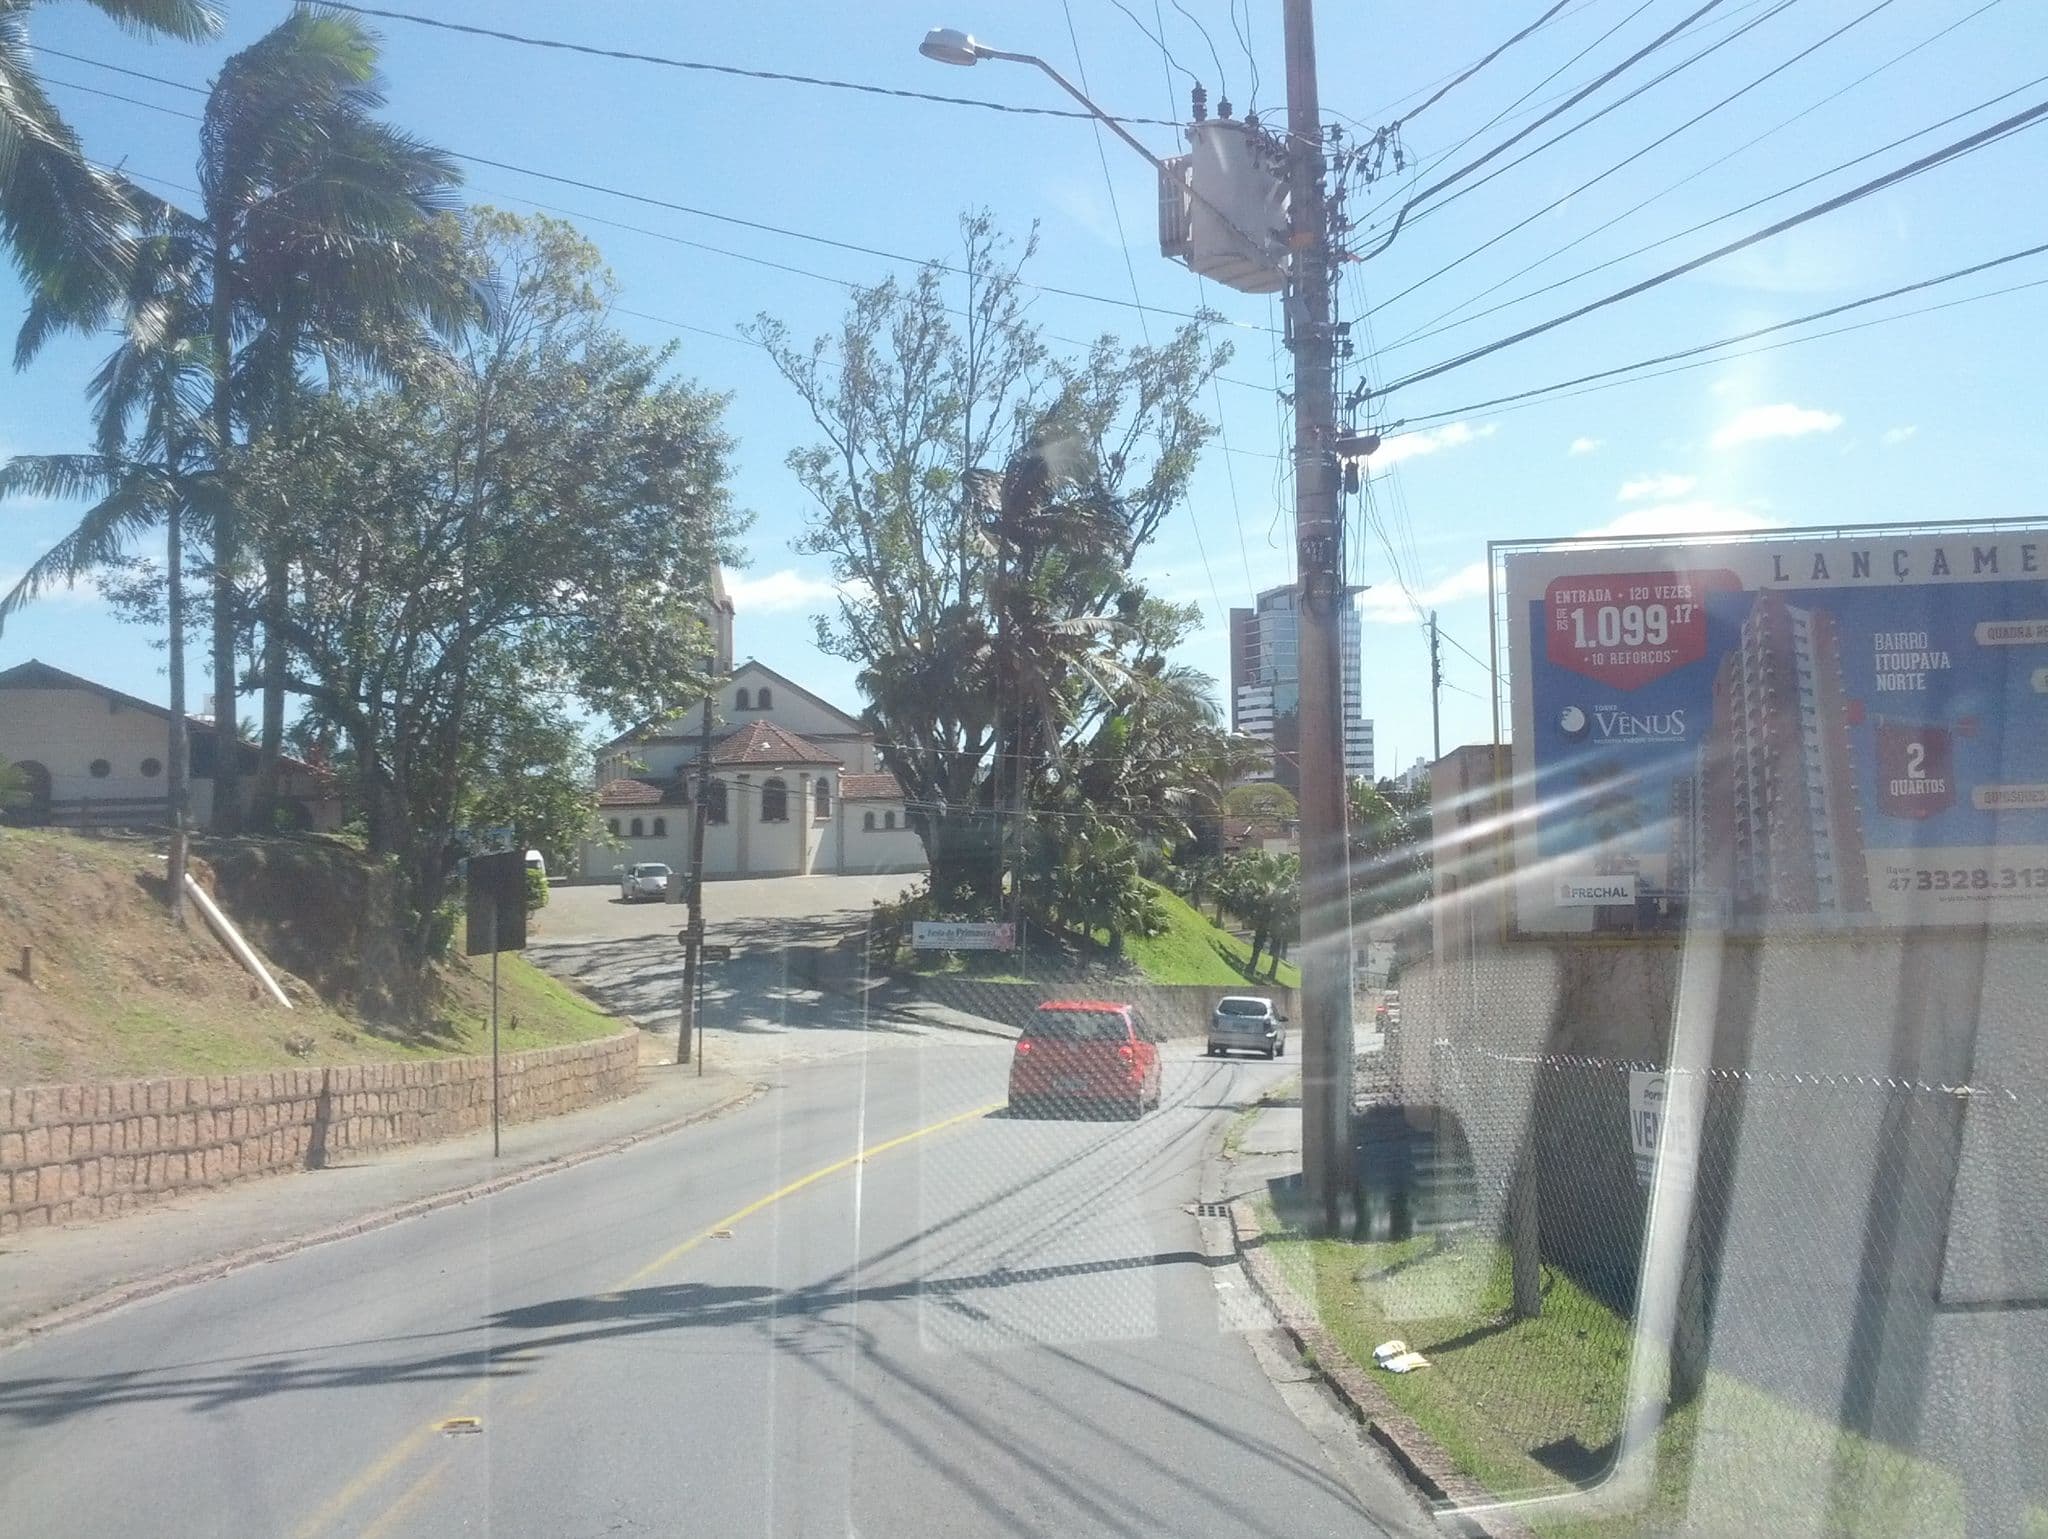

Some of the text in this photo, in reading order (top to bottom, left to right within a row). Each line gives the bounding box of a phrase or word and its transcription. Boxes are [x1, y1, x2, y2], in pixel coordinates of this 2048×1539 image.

[1555, 584, 1692, 604] ENTRADA 120 VEZES
[1556, 608, 1568, 619] DE
[1874, 631, 1928, 651] BAIRRO
[1874, 651, 1951, 671] ITOUPAVA
[1875, 673, 1927, 691] NORTE
[1906, 742, 1926, 779] 2
[1890, 778, 1946, 797] QUARTOS
[1571, 886, 1629, 898] FRECHAL
[1888, 877, 1911, 891] 47
